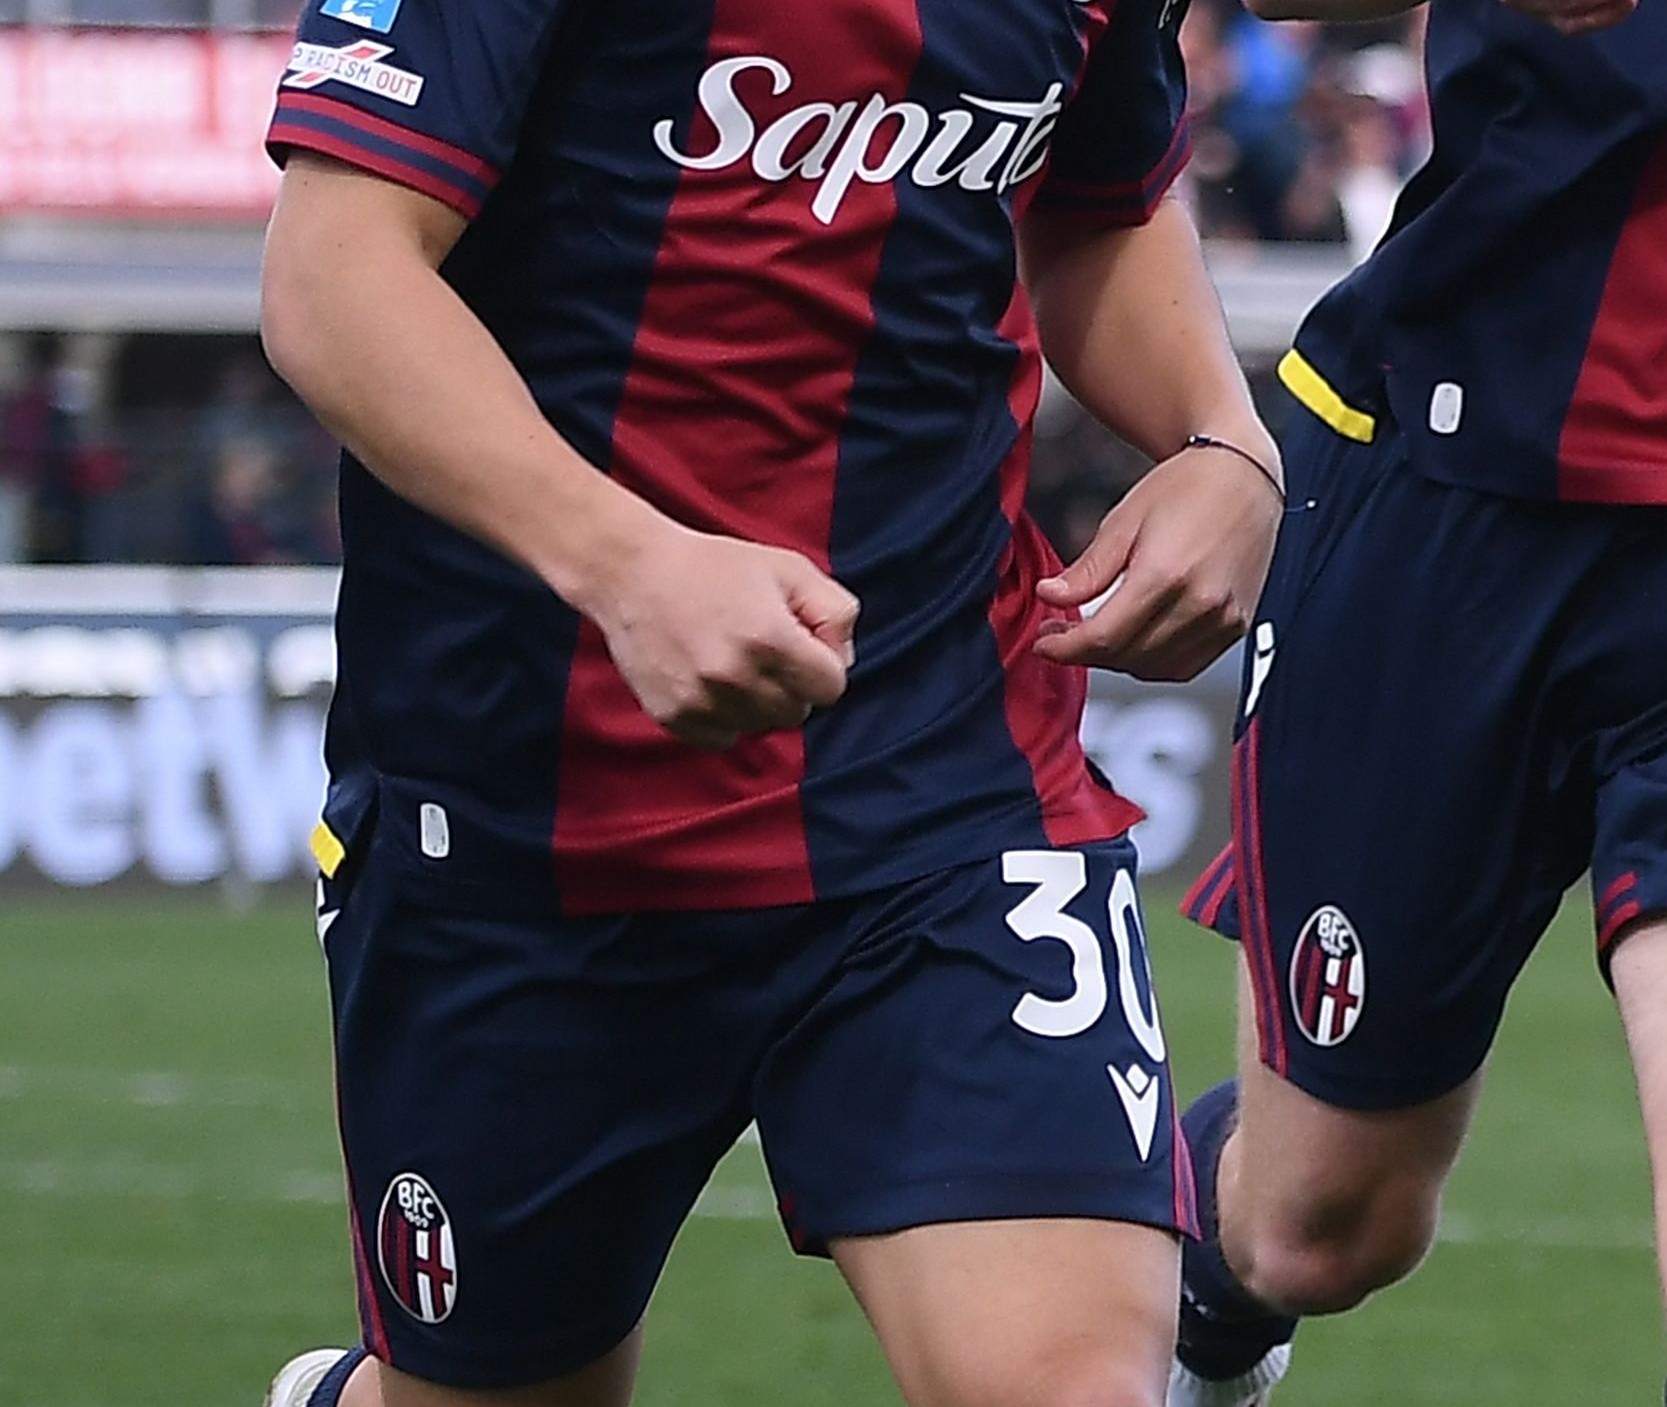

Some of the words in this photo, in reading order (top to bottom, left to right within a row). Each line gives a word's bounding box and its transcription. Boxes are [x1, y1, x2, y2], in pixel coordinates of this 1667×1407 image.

[376, 70, 417, 100] OUT
[1317, 913, 1350, 951] BFC
[1002, 850, 1166, 1064] 30
[397, 1180, 435, 1220] BFC
